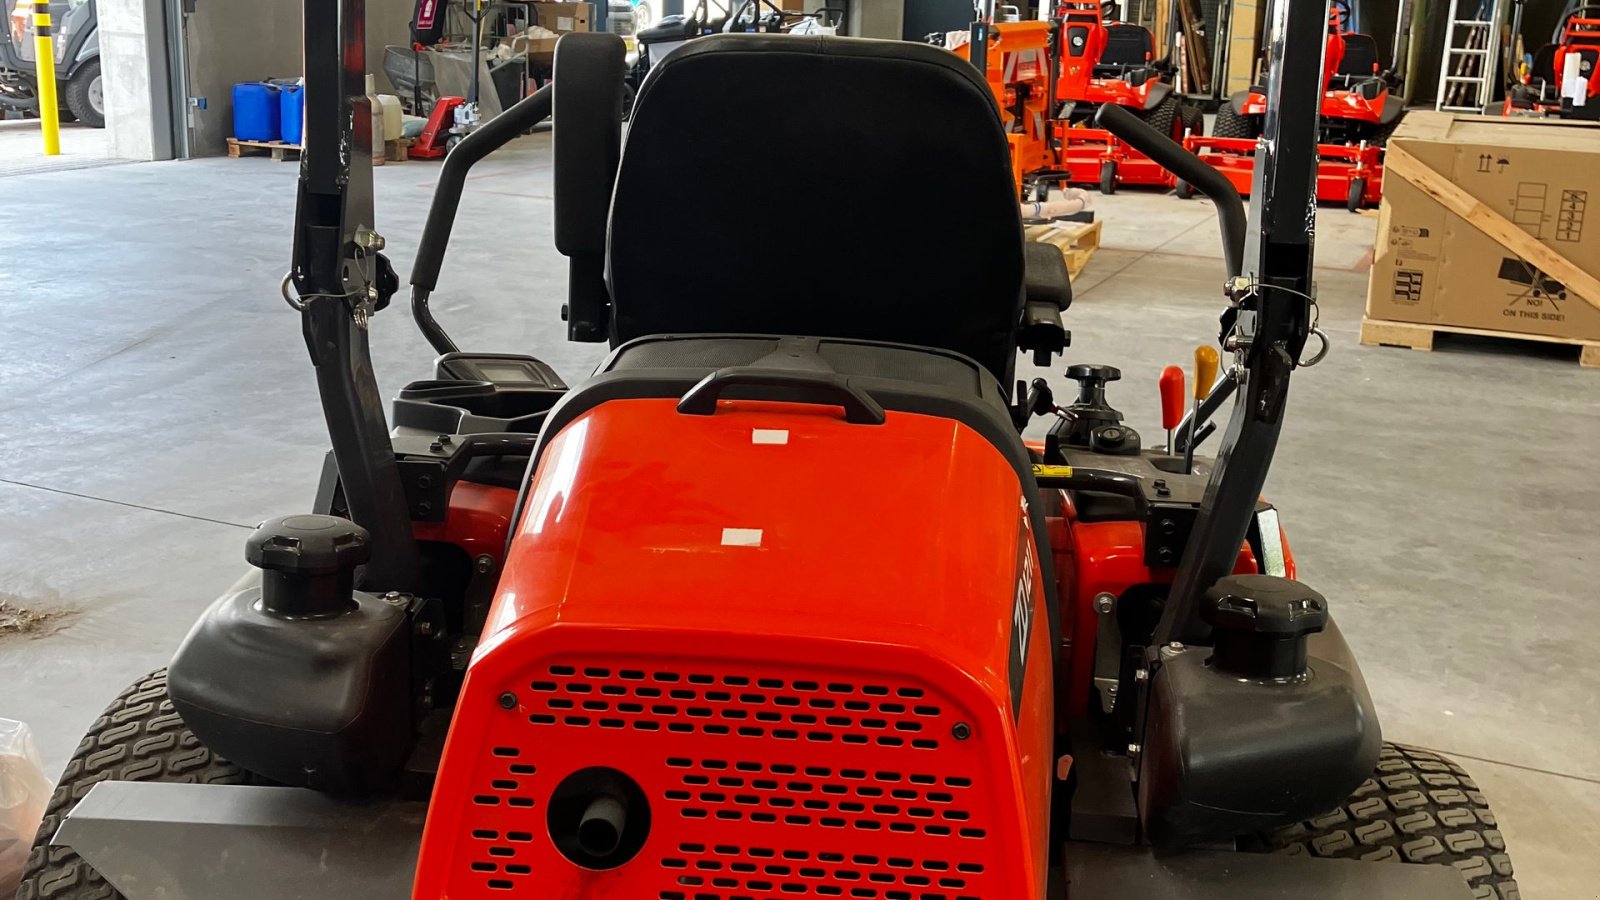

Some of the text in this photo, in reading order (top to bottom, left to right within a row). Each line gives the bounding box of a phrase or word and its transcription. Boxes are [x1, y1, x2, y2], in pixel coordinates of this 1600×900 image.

[1503, 309, 1565, 321] ON THIS SIDE!
